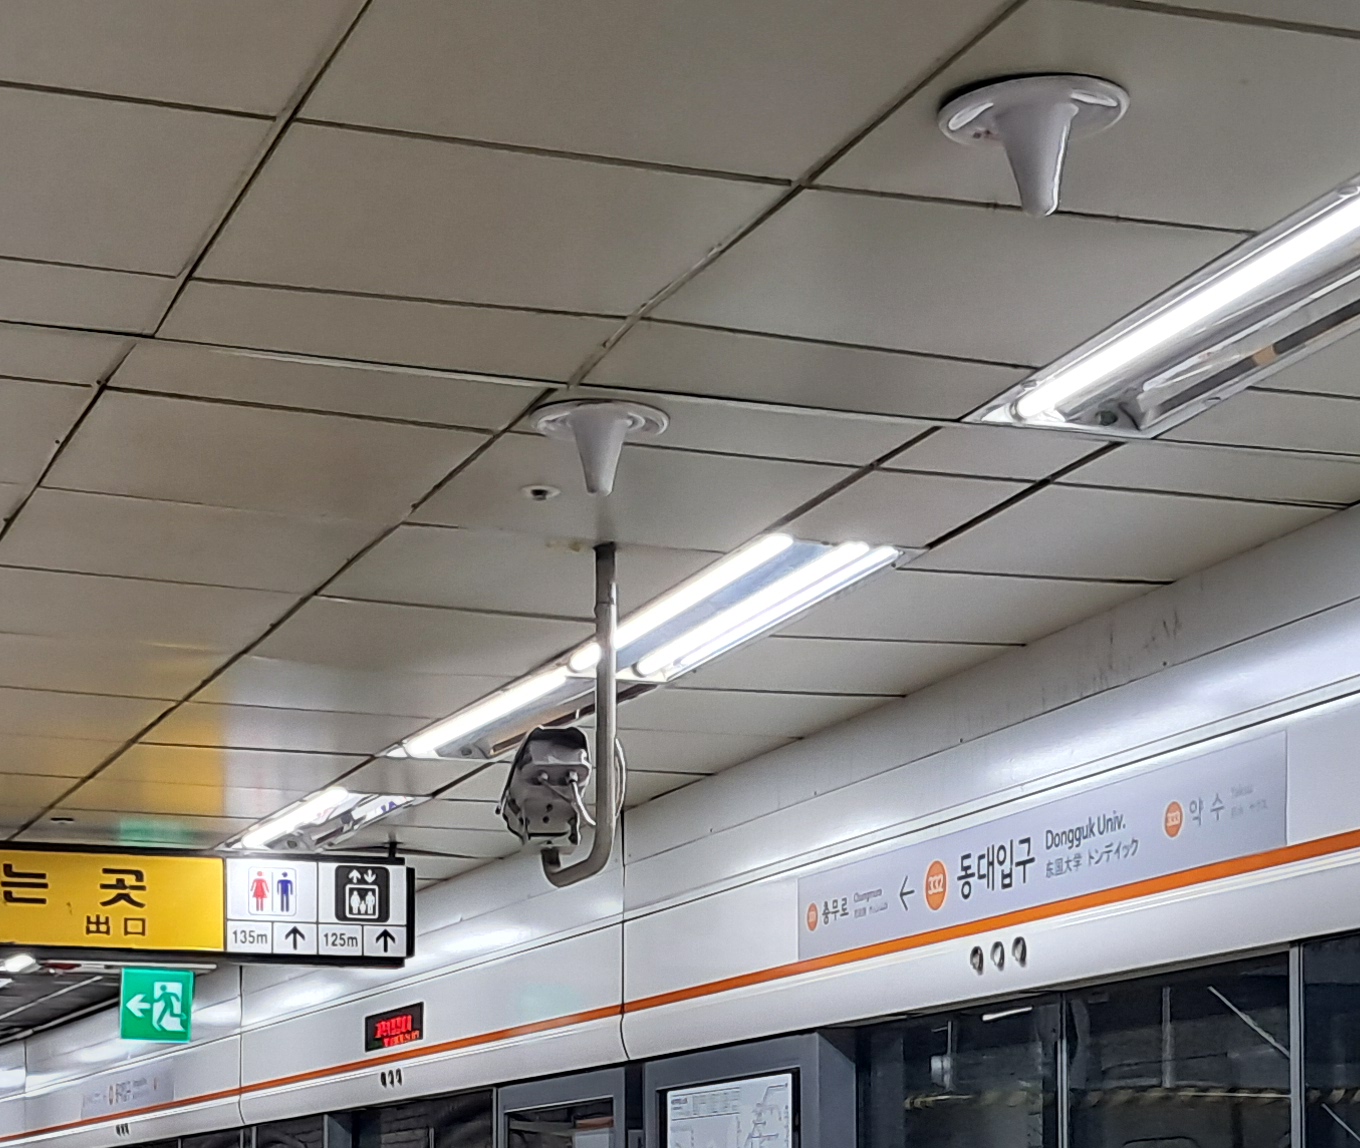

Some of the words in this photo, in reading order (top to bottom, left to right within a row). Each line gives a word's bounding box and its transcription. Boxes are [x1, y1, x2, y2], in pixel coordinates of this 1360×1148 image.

[1045, 817, 1096, 850] Dongguk
[1097, 810, 1127, 836] Univ.
[957, 837, 1035, 900] 동대입구
[99, 867, 147, 908] 곳
[86, 914, 146, 936] 出口
[232, 929, 268, 946] 135m
[323, 932, 358, 949] 125m
